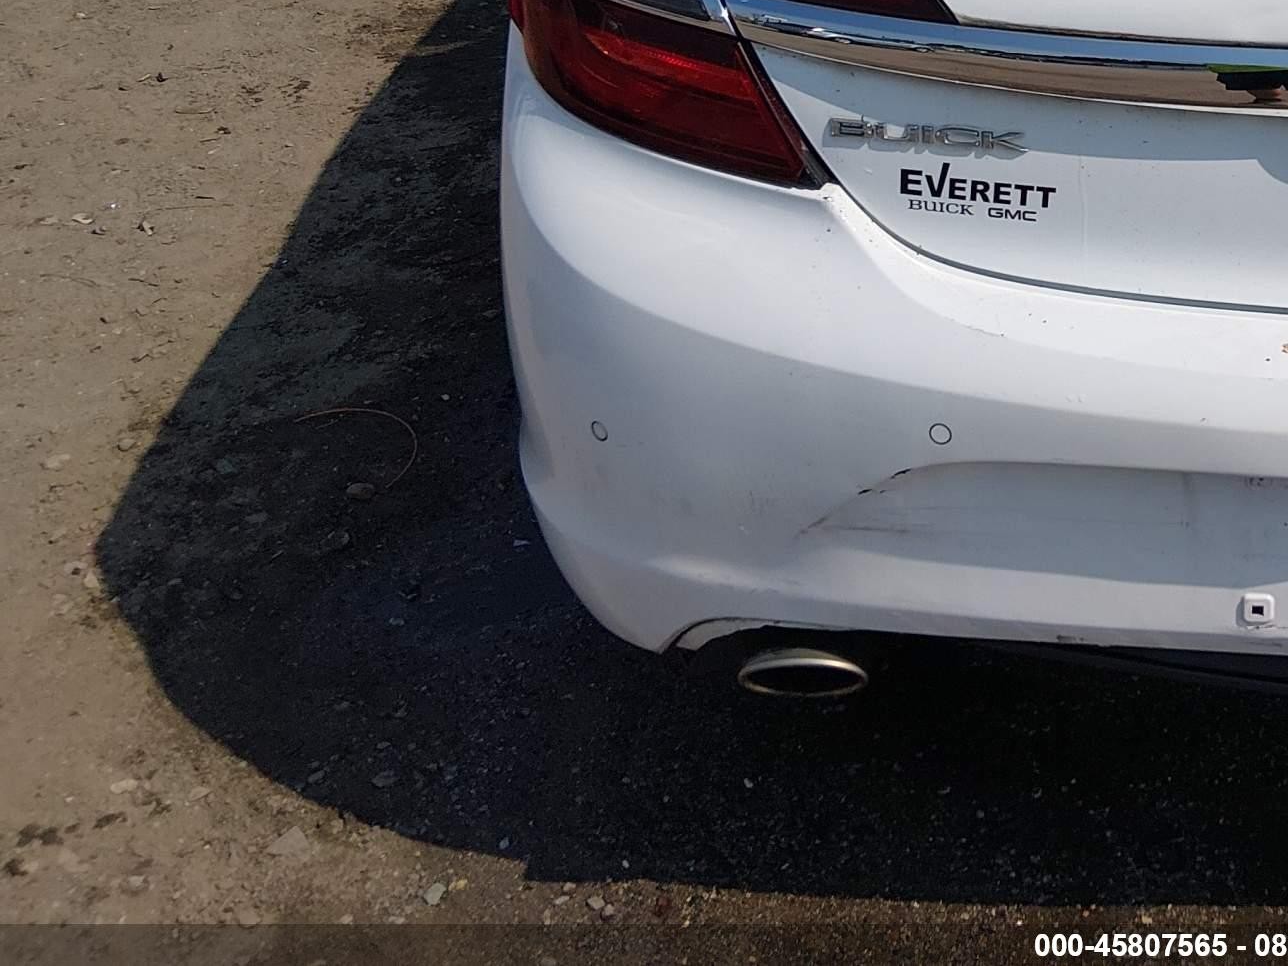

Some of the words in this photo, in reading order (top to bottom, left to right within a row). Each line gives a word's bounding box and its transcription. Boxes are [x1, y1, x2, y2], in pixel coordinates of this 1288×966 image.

[830, 116, 1029, 153] BUICK
[899, 162, 1057, 209] EVERETT
[908, 198, 975, 216] BUICK
[987, 207, 1038, 222] GMC
